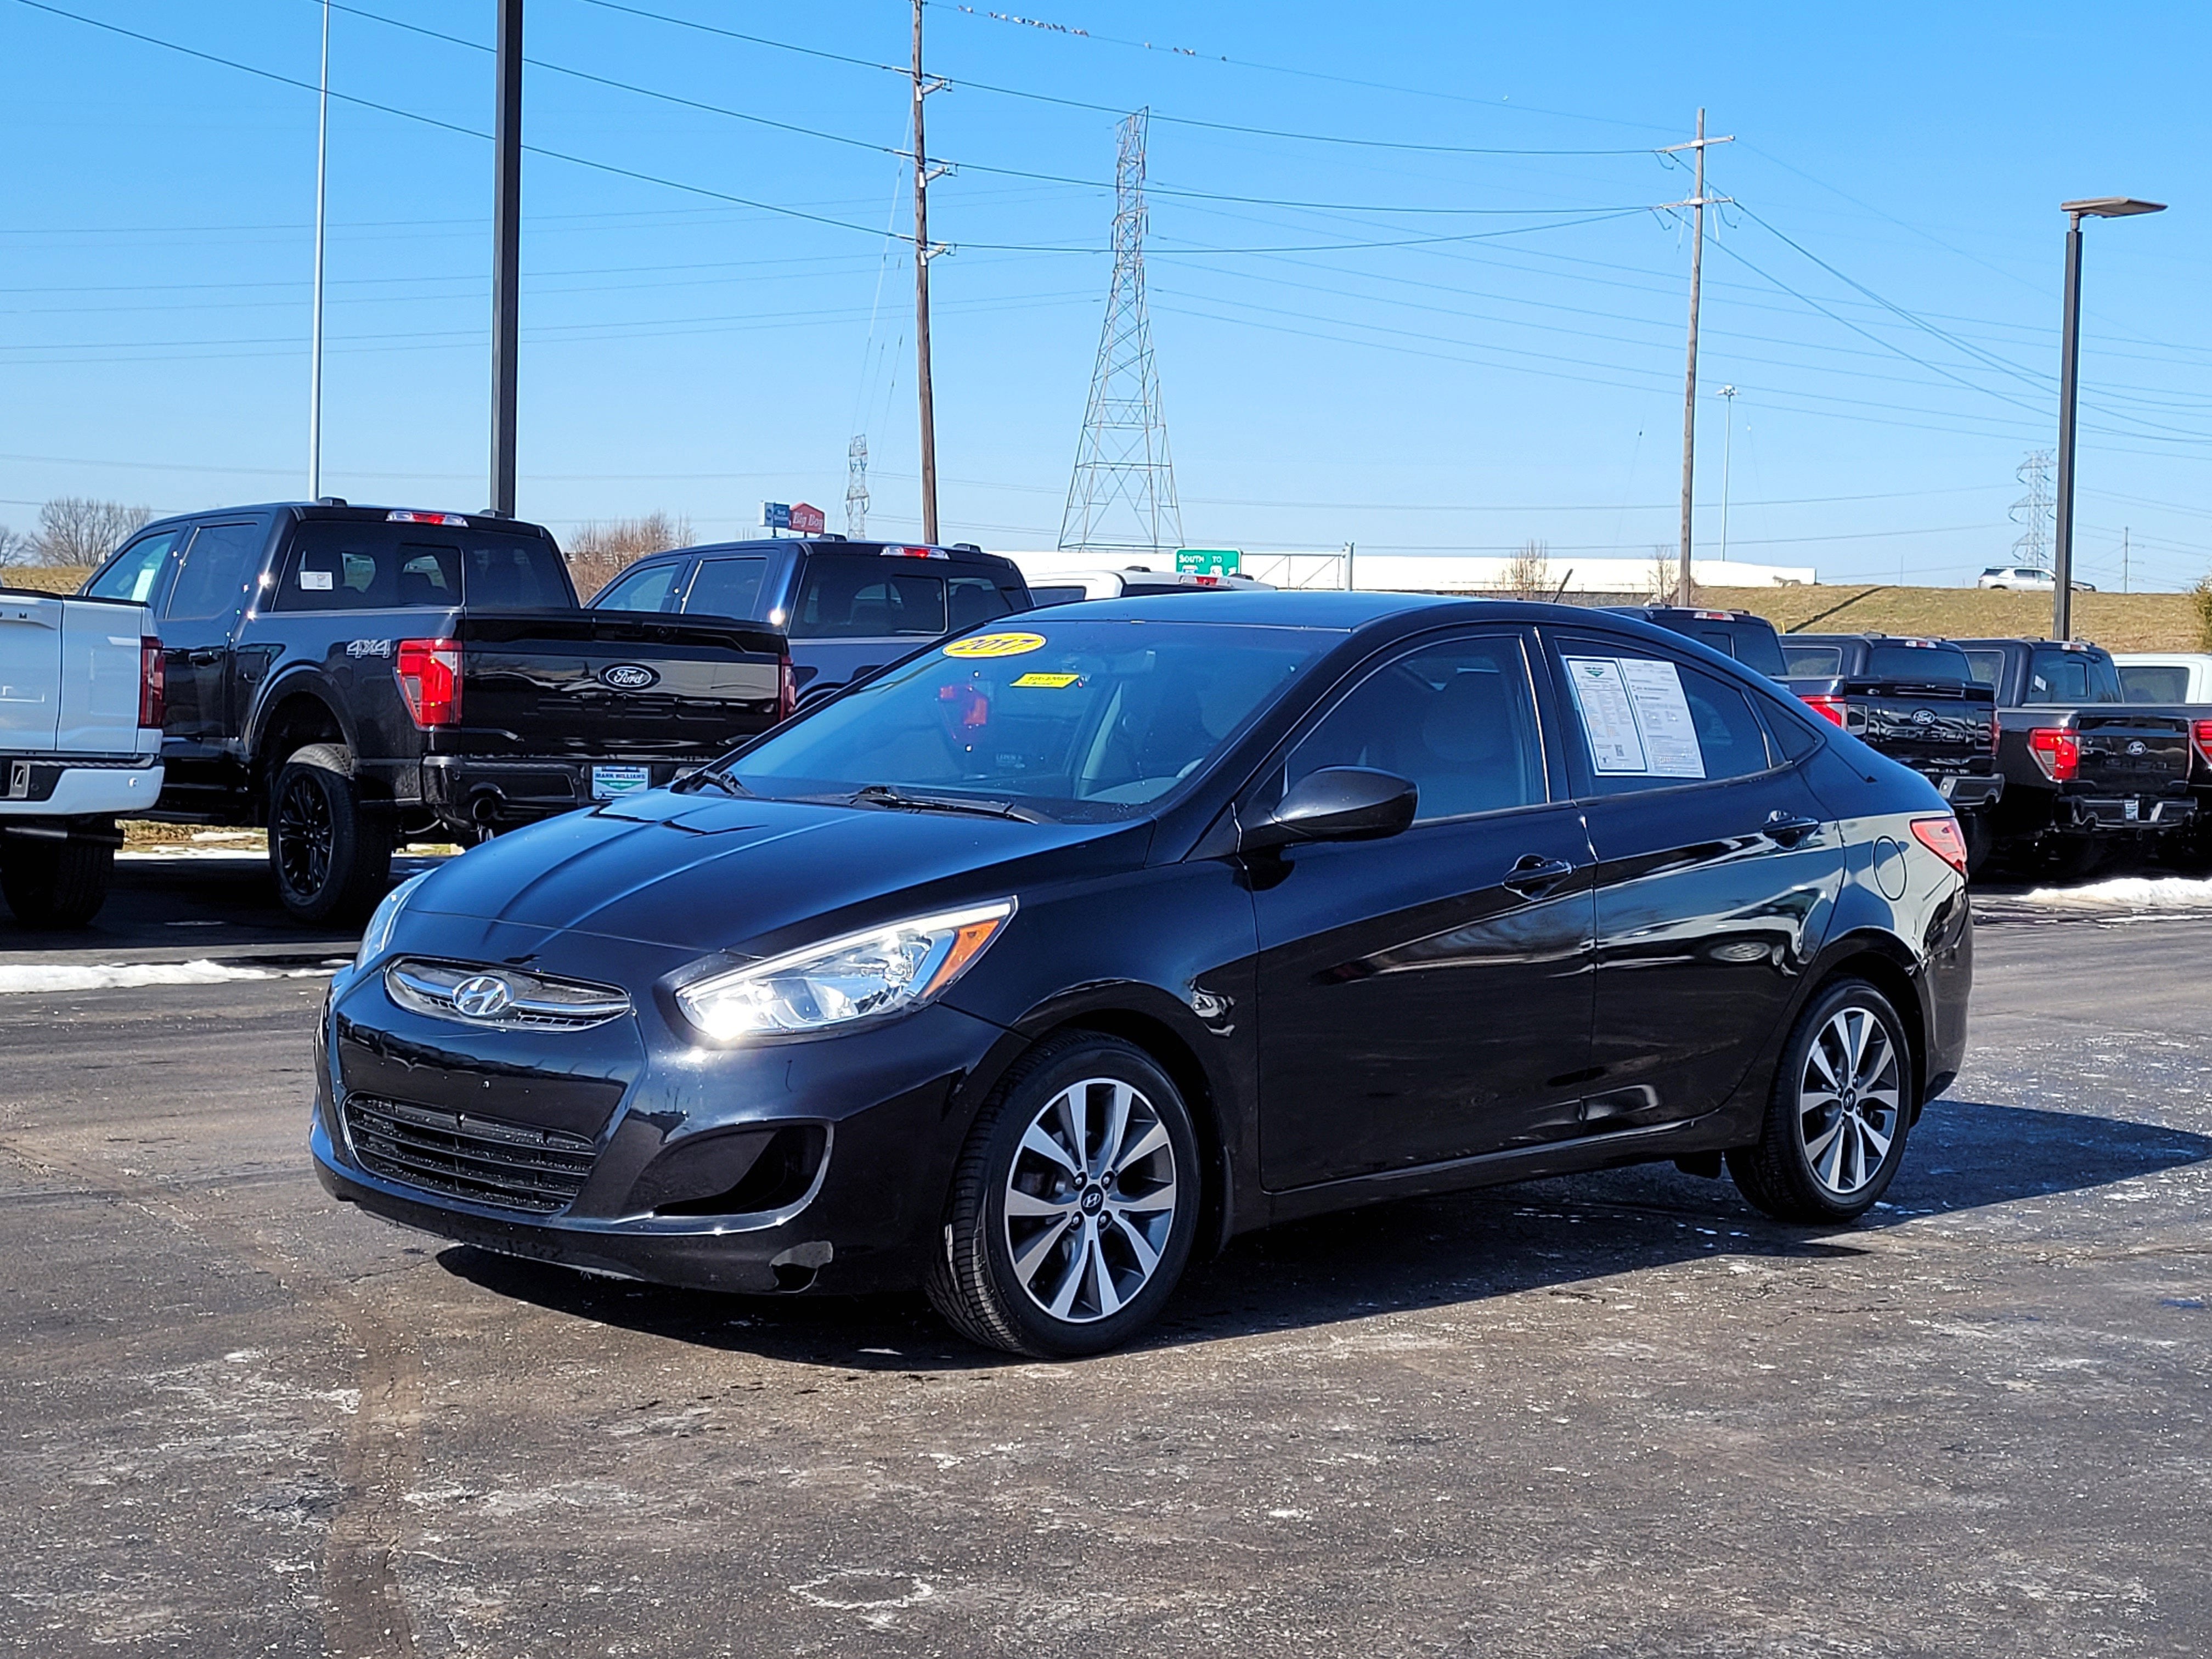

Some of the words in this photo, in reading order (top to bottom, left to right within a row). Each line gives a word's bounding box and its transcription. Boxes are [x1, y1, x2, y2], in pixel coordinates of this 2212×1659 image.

[1178, 554, 1205, 563] SOUTH
[1211, 555, 1223, 563] TO
[613, 669, 644, 684] Ford
